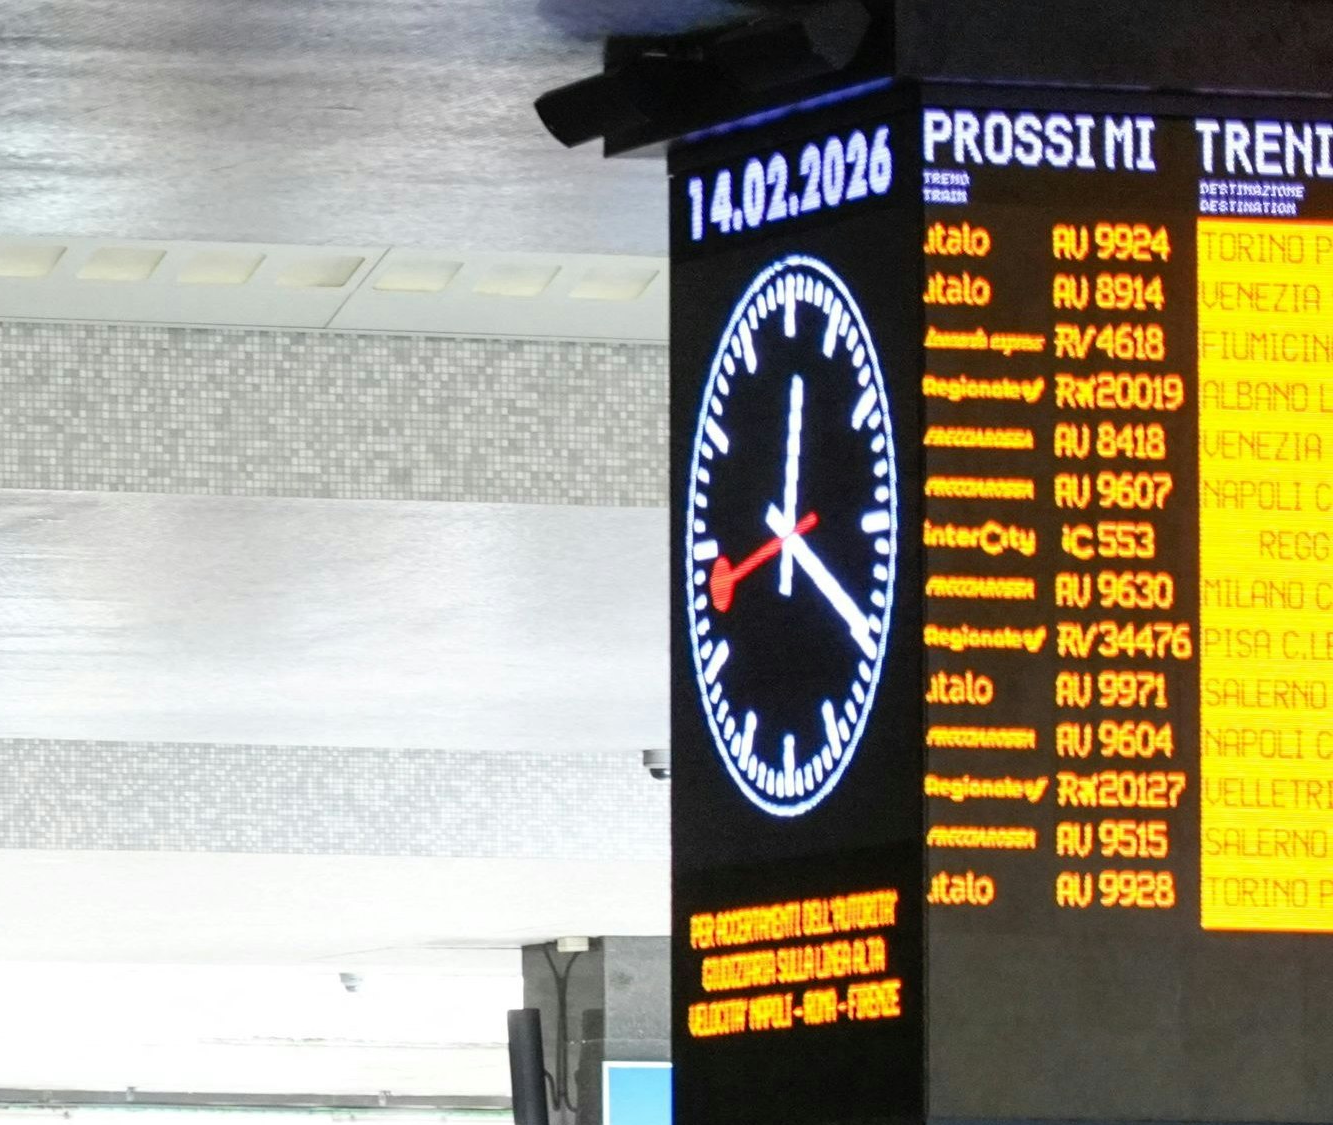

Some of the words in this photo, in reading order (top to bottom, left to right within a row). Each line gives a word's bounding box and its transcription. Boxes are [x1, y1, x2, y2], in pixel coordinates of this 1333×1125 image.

[924, 109, 1155, 171] PROSSIMI
[1196, 119, 1333, 177] TRENI
[688, 126, 892, 240] 14.02.2026
[1199, 197, 1297, 216] DESTINATION
[1095, 222, 1171, 262] 9924
[1202, 232, 1303, 264] TORINO
[1095, 272, 1165, 310] 8914
[1203, 281, 1320, 312] VENEZIA
[1055, 323, 1097, 361] RV
[1097, 322, 1166, 361] 4618
[1202, 331, 1333, 362] FIUMICIN
[1095, 371, 1184, 411] 20019
[1203, 380, 1308, 412] ALBANO
[1095, 421, 1166, 460] 8418
[1203, 430, 1322, 461] VENEZIA
[1095, 471, 1173, 509] 9607
[1203, 480, 1302, 511] NAPOLI
[1095, 521, 1155, 560] 553
[1095, 570, 1174, 609] 9630
[1204, 579, 1304, 610] MILANO
[1055, 621, 1097, 659] RV
[1097, 620, 1193, 659] 34476
[1204, 628, 1271, 659] PISA
[1095, 670, 1168, 708] 9971
[1205, 678, 1327, 709] SALERNO
[1095, 720, 1174, 758] 9604
[1205, 729, 1303, 759] NAPOLI
[1095, 770, 1186, 808] 20127
[1095, 819, 1169, 858] 9515
[1205, 827, 1327, 858] SALERNO
[1095, 869, 1176, 908] 9928
[1207, 877, 1308, 907] TORINO
